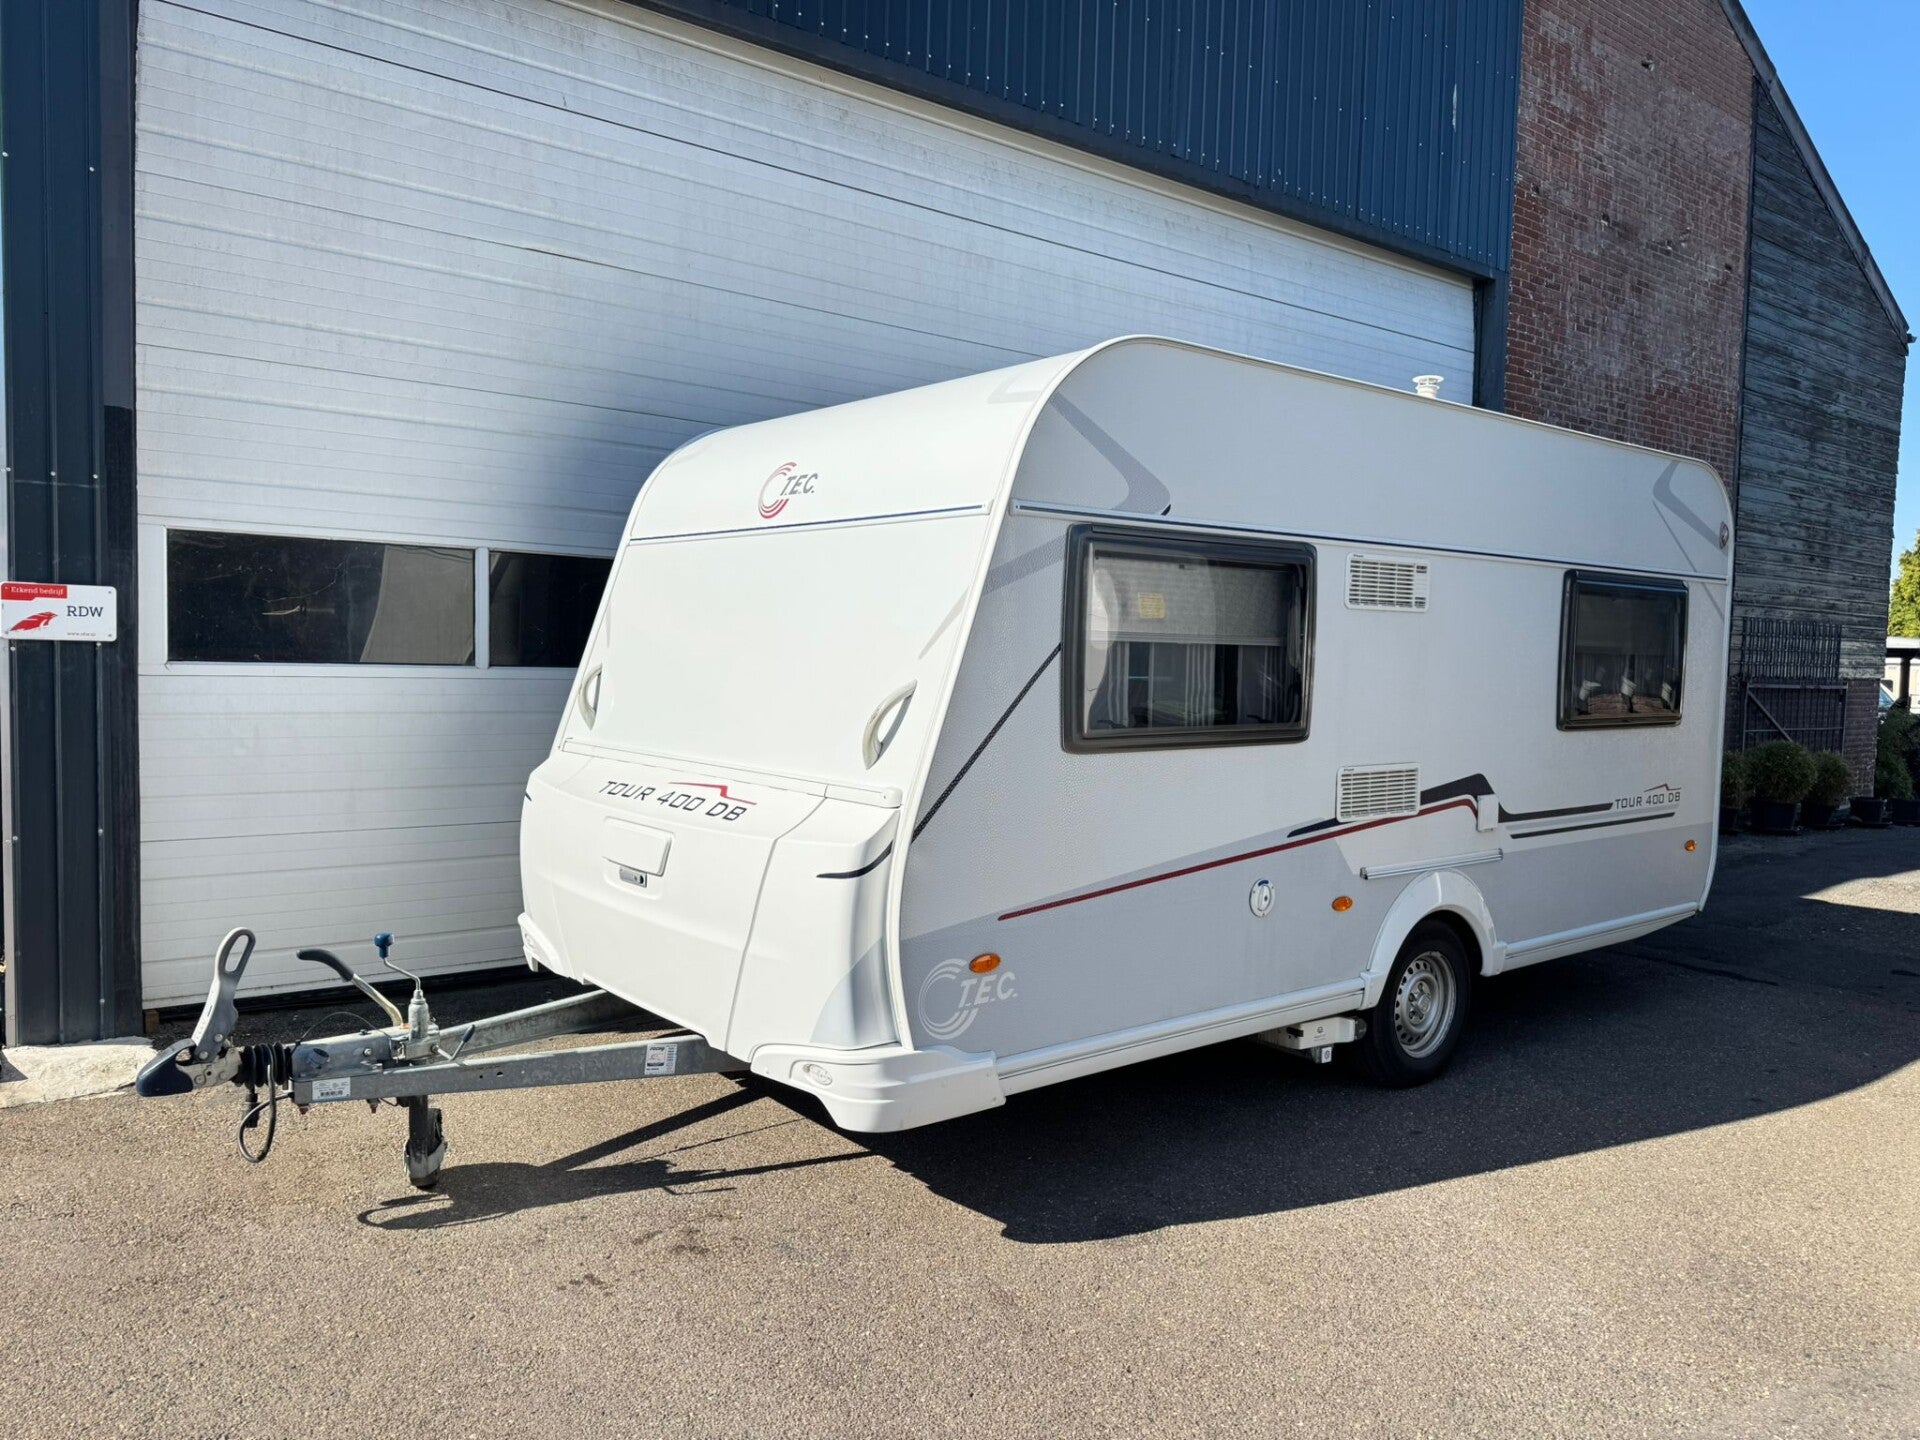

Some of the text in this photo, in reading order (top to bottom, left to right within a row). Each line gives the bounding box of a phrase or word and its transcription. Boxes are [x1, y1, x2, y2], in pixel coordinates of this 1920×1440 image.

[11, 586, 64, 596] Erkend bedrijf
[67, 605, 104, 617] RDW
[599, 780, 747, 821] TOUR 400 DB
[1615, 791, 1681, 810] TOUR 400 DB
